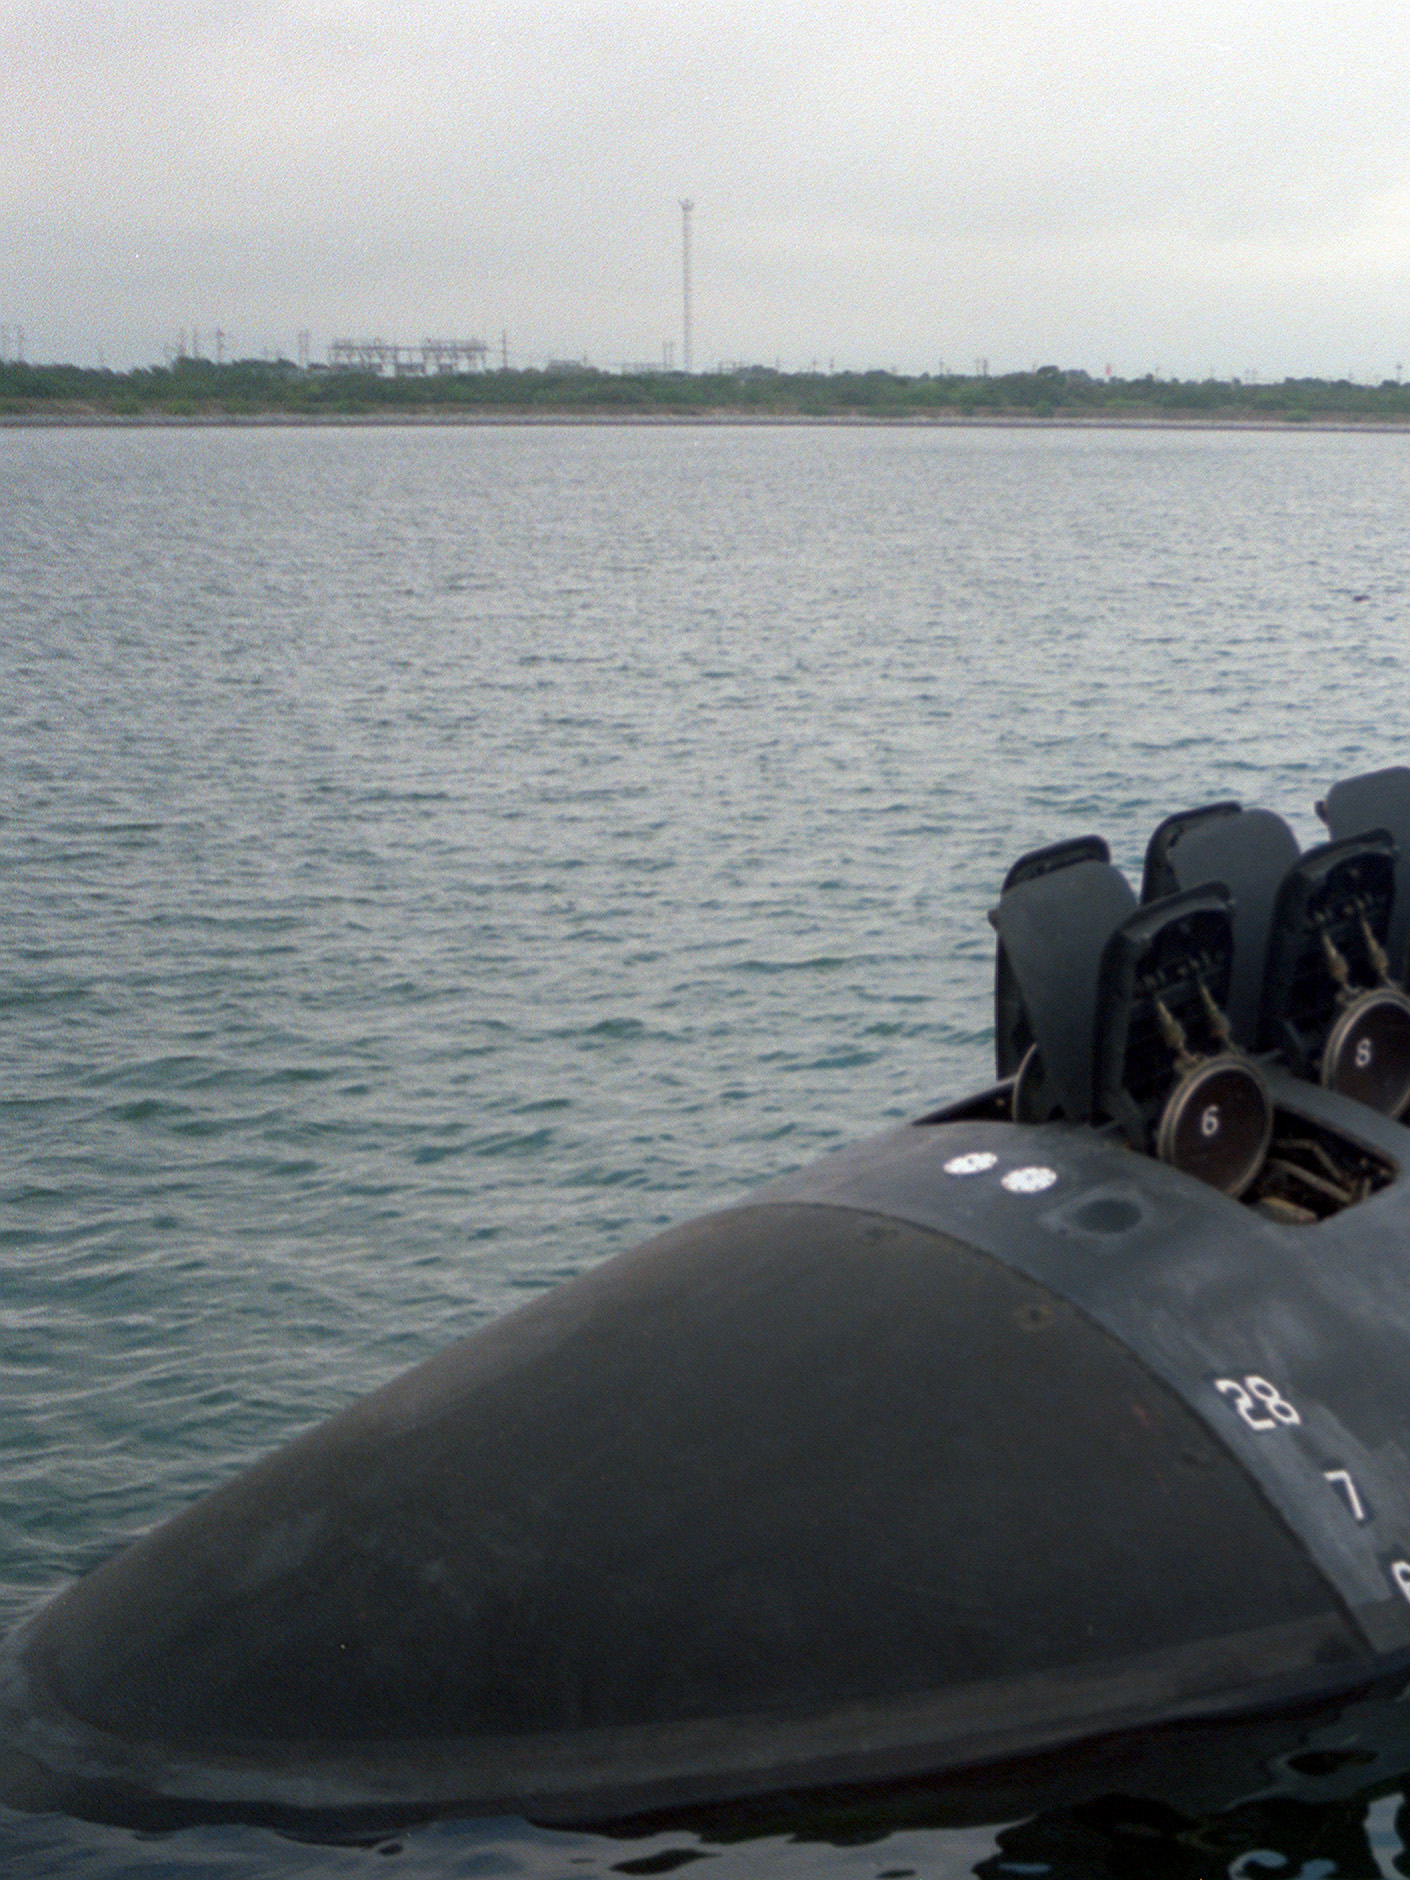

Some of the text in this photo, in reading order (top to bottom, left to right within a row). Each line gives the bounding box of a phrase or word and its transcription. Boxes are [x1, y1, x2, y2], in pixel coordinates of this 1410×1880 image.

[1201, 1104, 1219, 1136] 6
[1215, 1375, 1303, 1431] 28
[1323, 1469, 1365, 1520] 7
